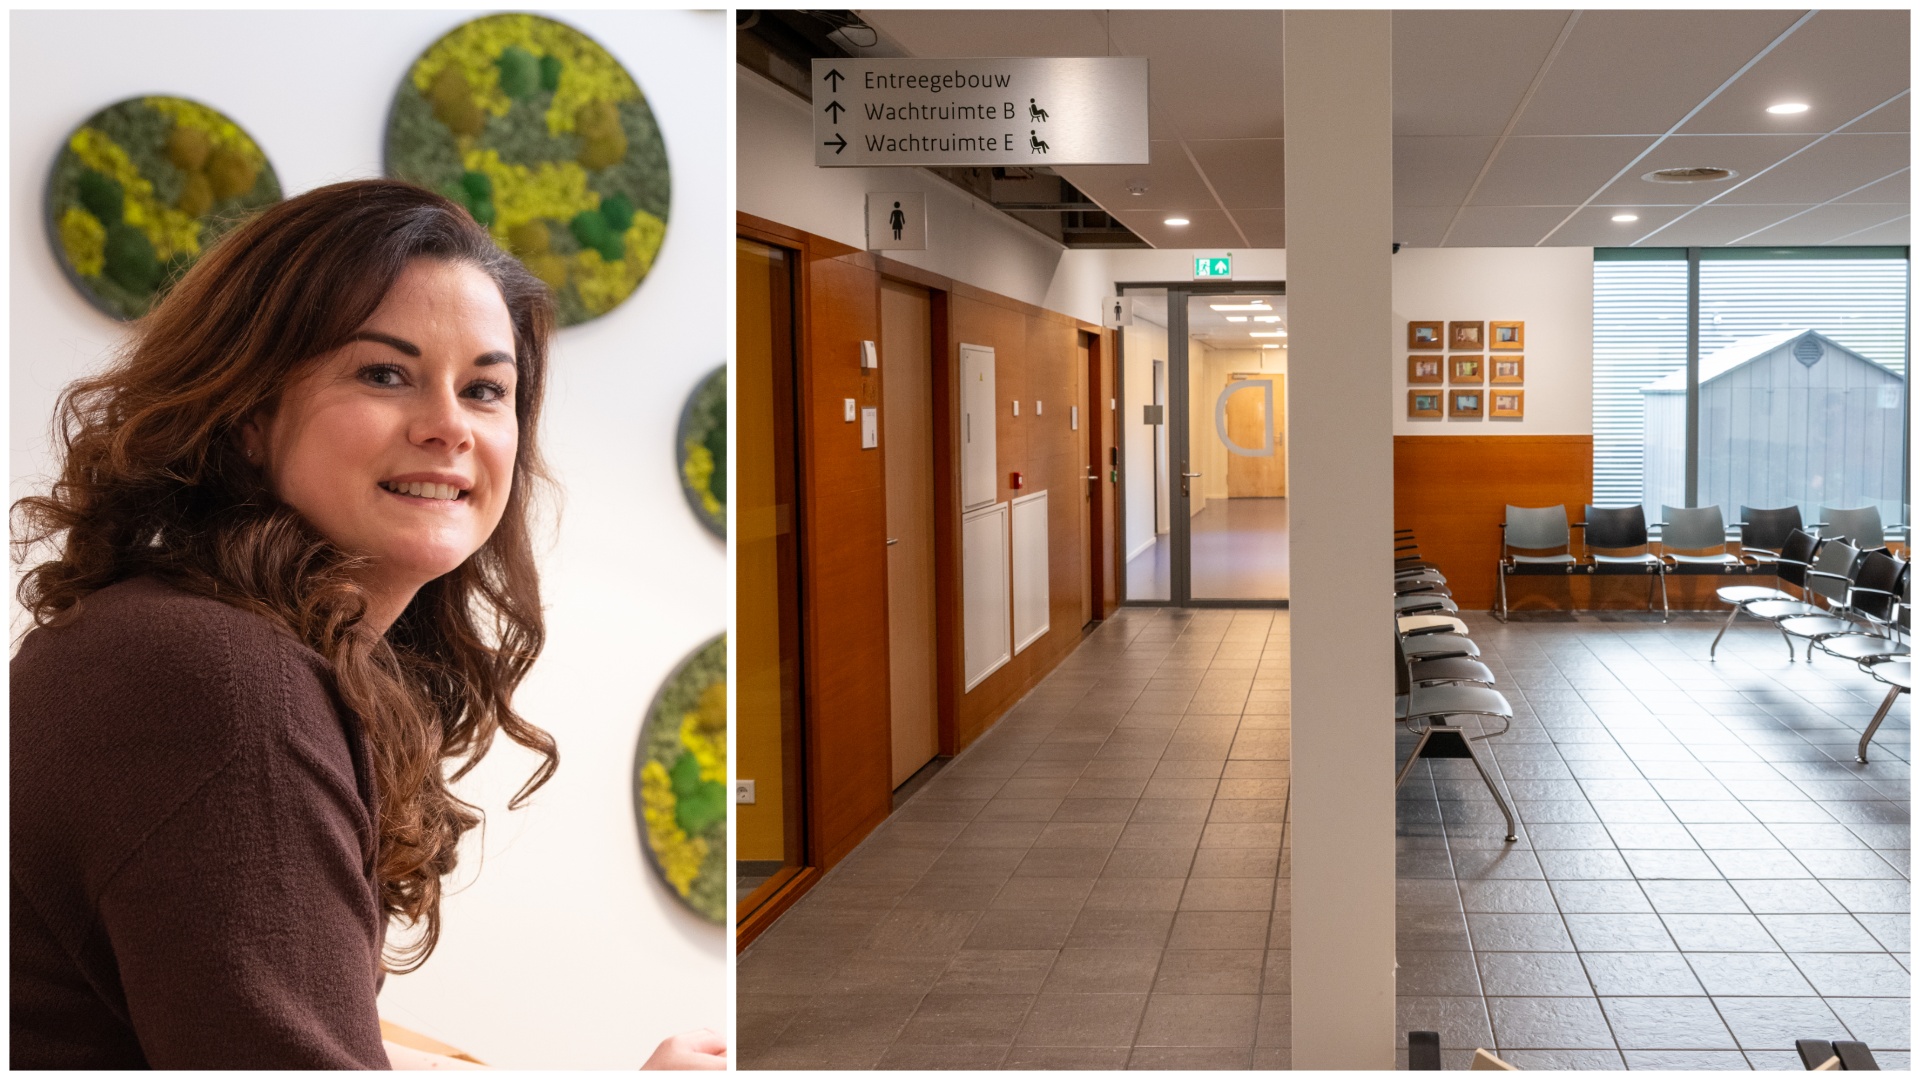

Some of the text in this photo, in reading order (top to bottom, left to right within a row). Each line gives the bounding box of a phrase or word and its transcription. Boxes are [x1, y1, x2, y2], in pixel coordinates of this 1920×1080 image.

[864, 70, 1011, 93] Entreegebouw
[864, 101, 1015, 120] Wachtruimte B
[864, 132, 1014, 151] Wachtruimte E
